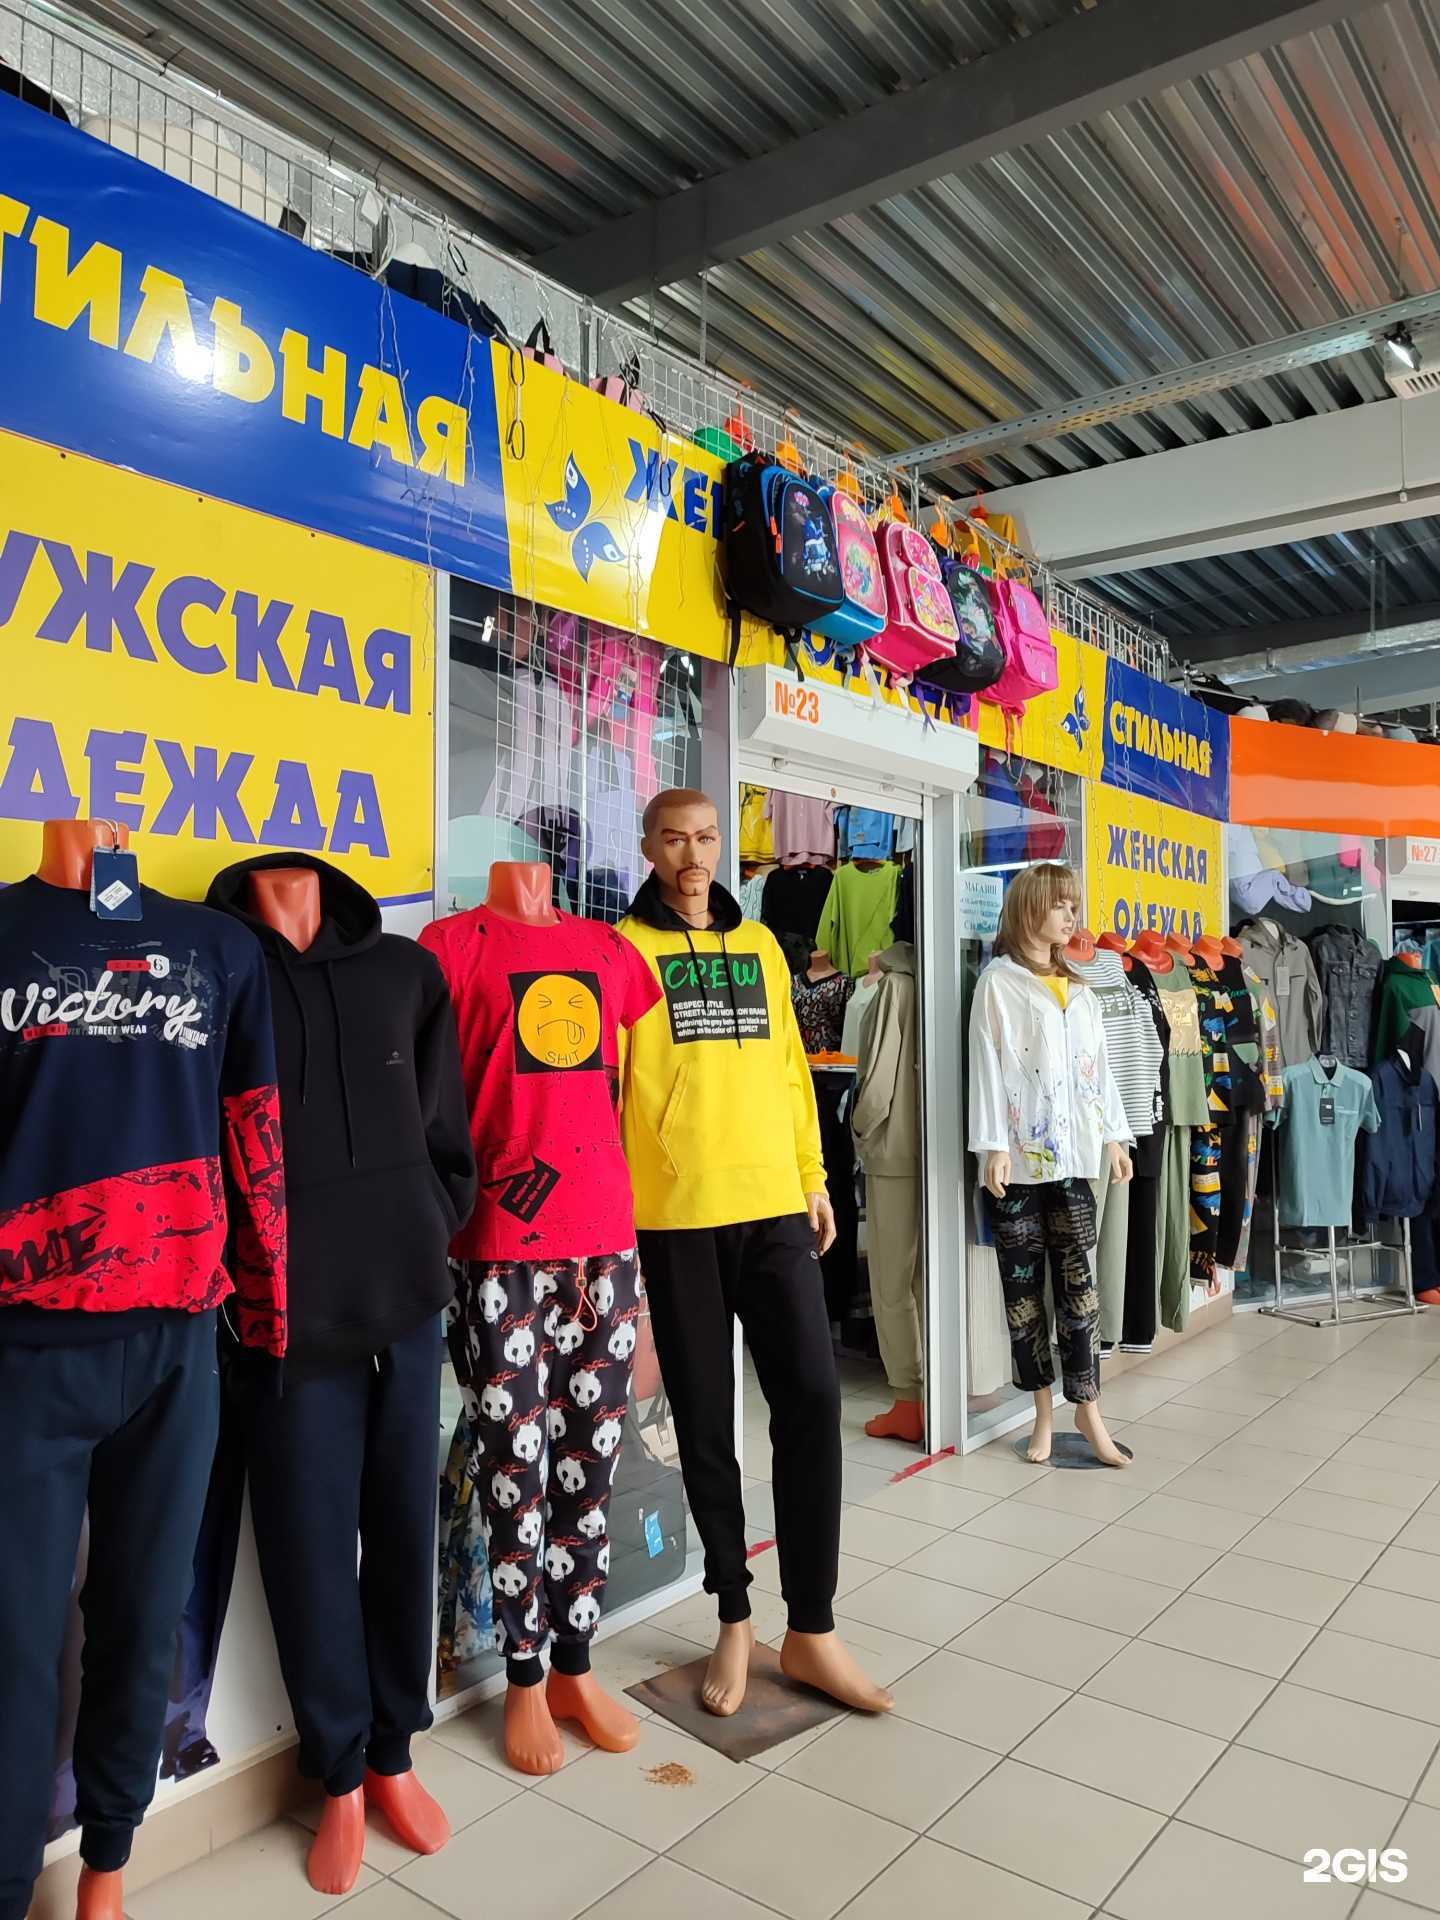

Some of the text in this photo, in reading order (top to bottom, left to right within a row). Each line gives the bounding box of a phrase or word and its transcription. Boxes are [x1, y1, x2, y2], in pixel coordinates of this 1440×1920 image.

[774, 680, 820, 725] №23
[1110, 701, 1211, 778] СТИЛЬНАЯ
[1107, 824, 1207, 885] ЖЕНСКАЯ
[665, 959, 758, 989] CREW
[0, 970, 202, 1041] Victory
[672, 1000, 704, 1011] RESPECT
[673, 1008, 701, 1019] STREET
[88, 1025, 117, 1036] STREET
[120, 1024, 147, 1036] WEAR
[545, 1050, 581, 1066] SHIT
